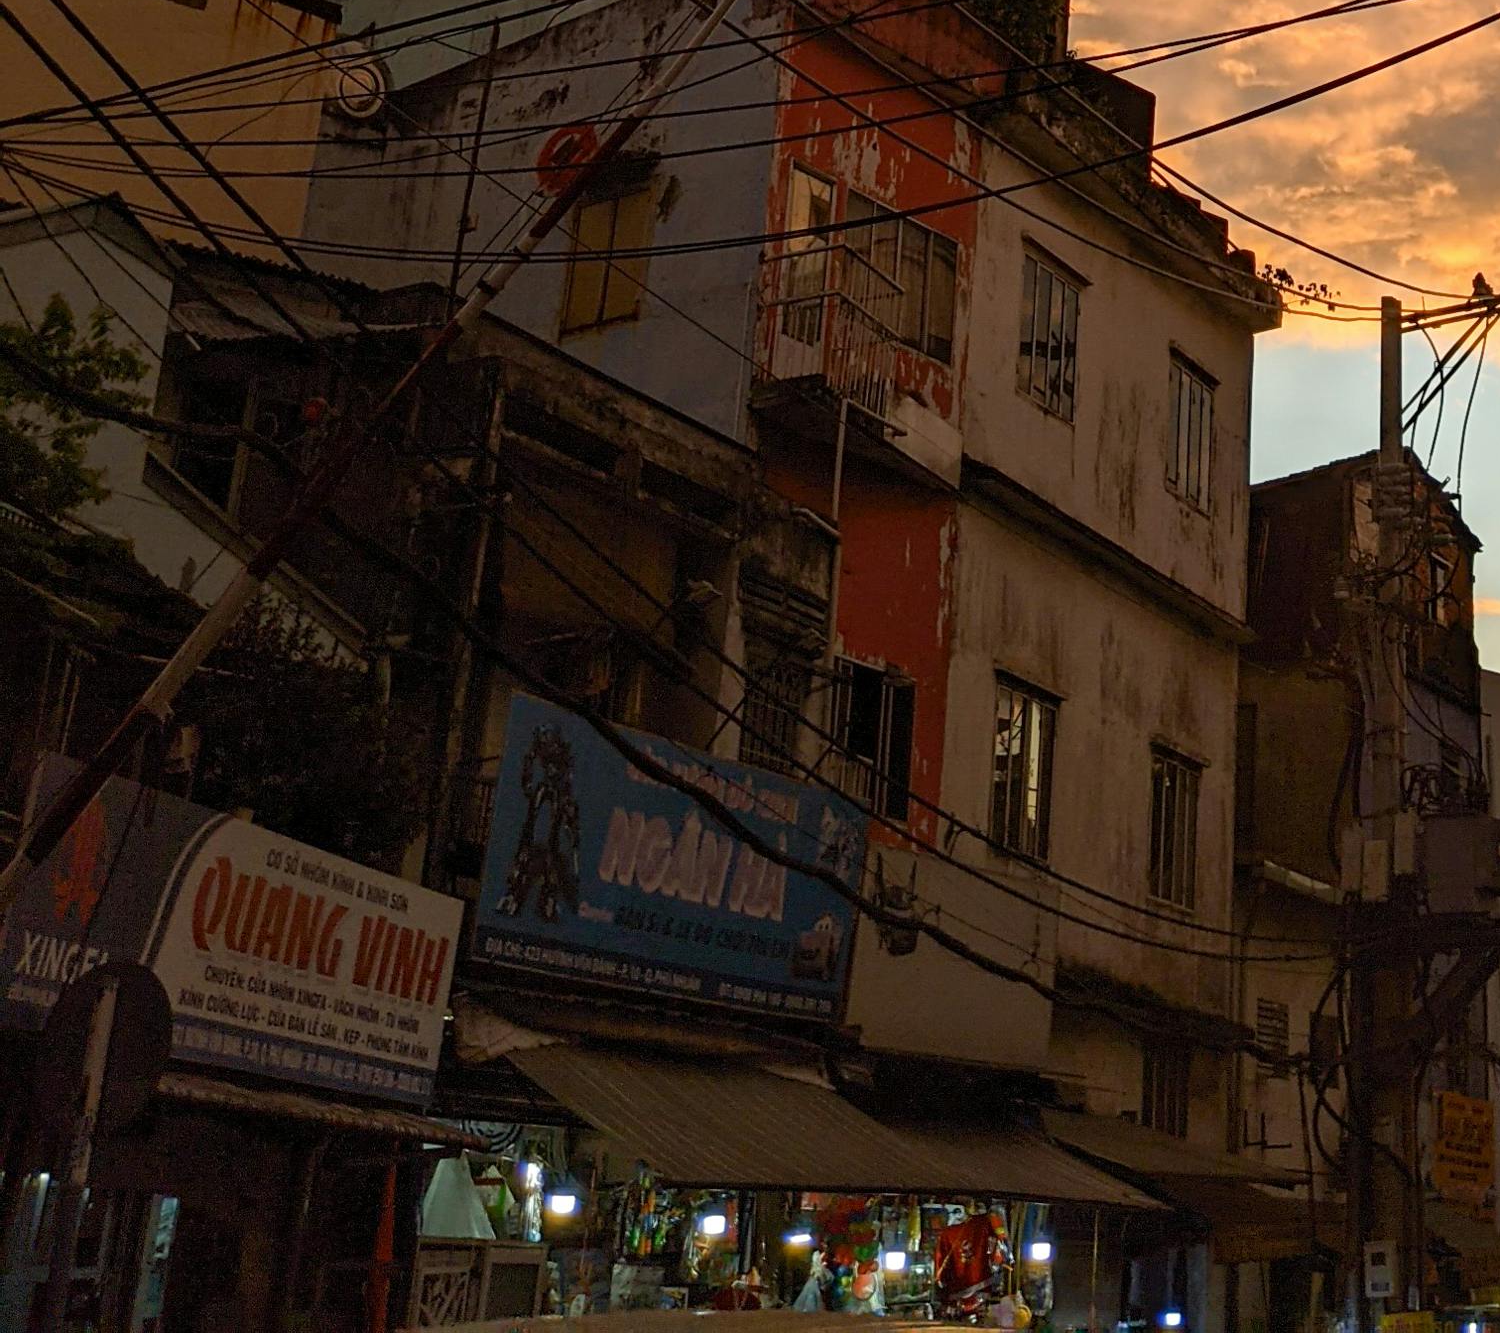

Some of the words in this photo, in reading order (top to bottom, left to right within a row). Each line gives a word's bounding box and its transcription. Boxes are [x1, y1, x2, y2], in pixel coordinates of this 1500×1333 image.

[16, 929, 110, 984] XINGF
[192, 856, 349, 978] QUANG
[352, 915, 450, 1005] VINH
